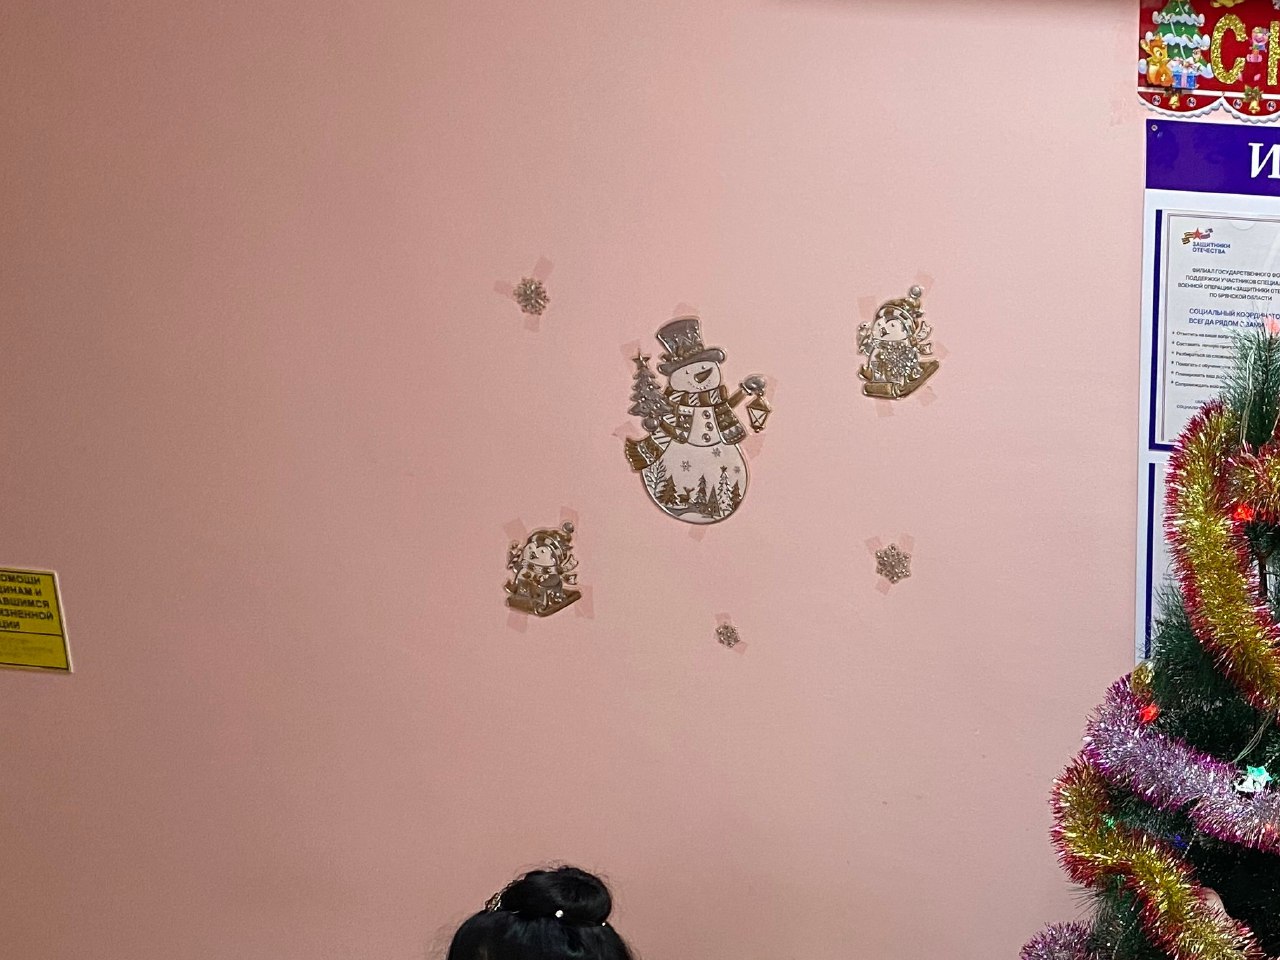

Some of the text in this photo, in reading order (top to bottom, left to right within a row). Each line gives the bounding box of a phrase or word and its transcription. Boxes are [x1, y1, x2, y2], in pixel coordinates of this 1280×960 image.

[1211, 13, 1246, 85] С
[1192, 241, 1231, 249] ЗАЩИТНИКИ
[1215, 269, 1271, 278] ГОСУДАРСТВЕННОГО
[1221, 277, 1257, 285] УЧАСТНИКОВ
[1189, 308, 1236, 318] СОЦИАЛЬНЫЙ
[1188, 318, 1215, 326] ВСЕГДА
[1215, 319, 1239, 327] РЯДОМ
